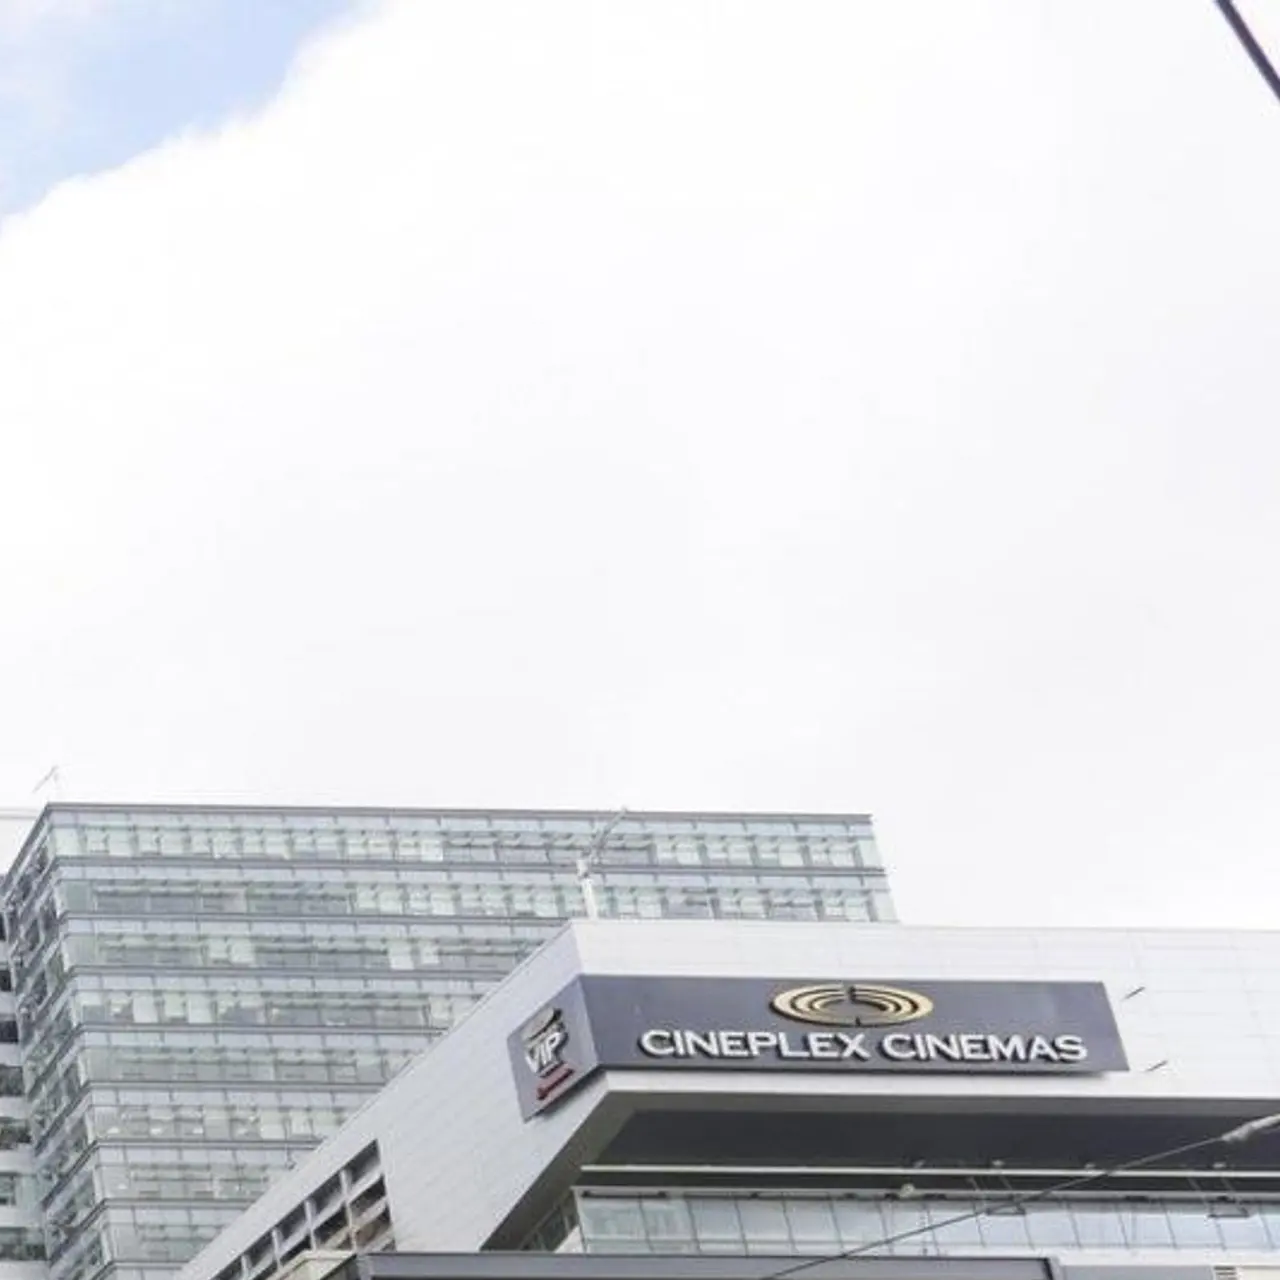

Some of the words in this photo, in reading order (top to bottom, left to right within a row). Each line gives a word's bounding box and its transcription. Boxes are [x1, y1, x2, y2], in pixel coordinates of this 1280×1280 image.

[525, 1032, 563, 1074] VIP
[639, 1029, 871, 1060] CINEPLEX
[880, 1032, 1088, 1063] CINEMAS
